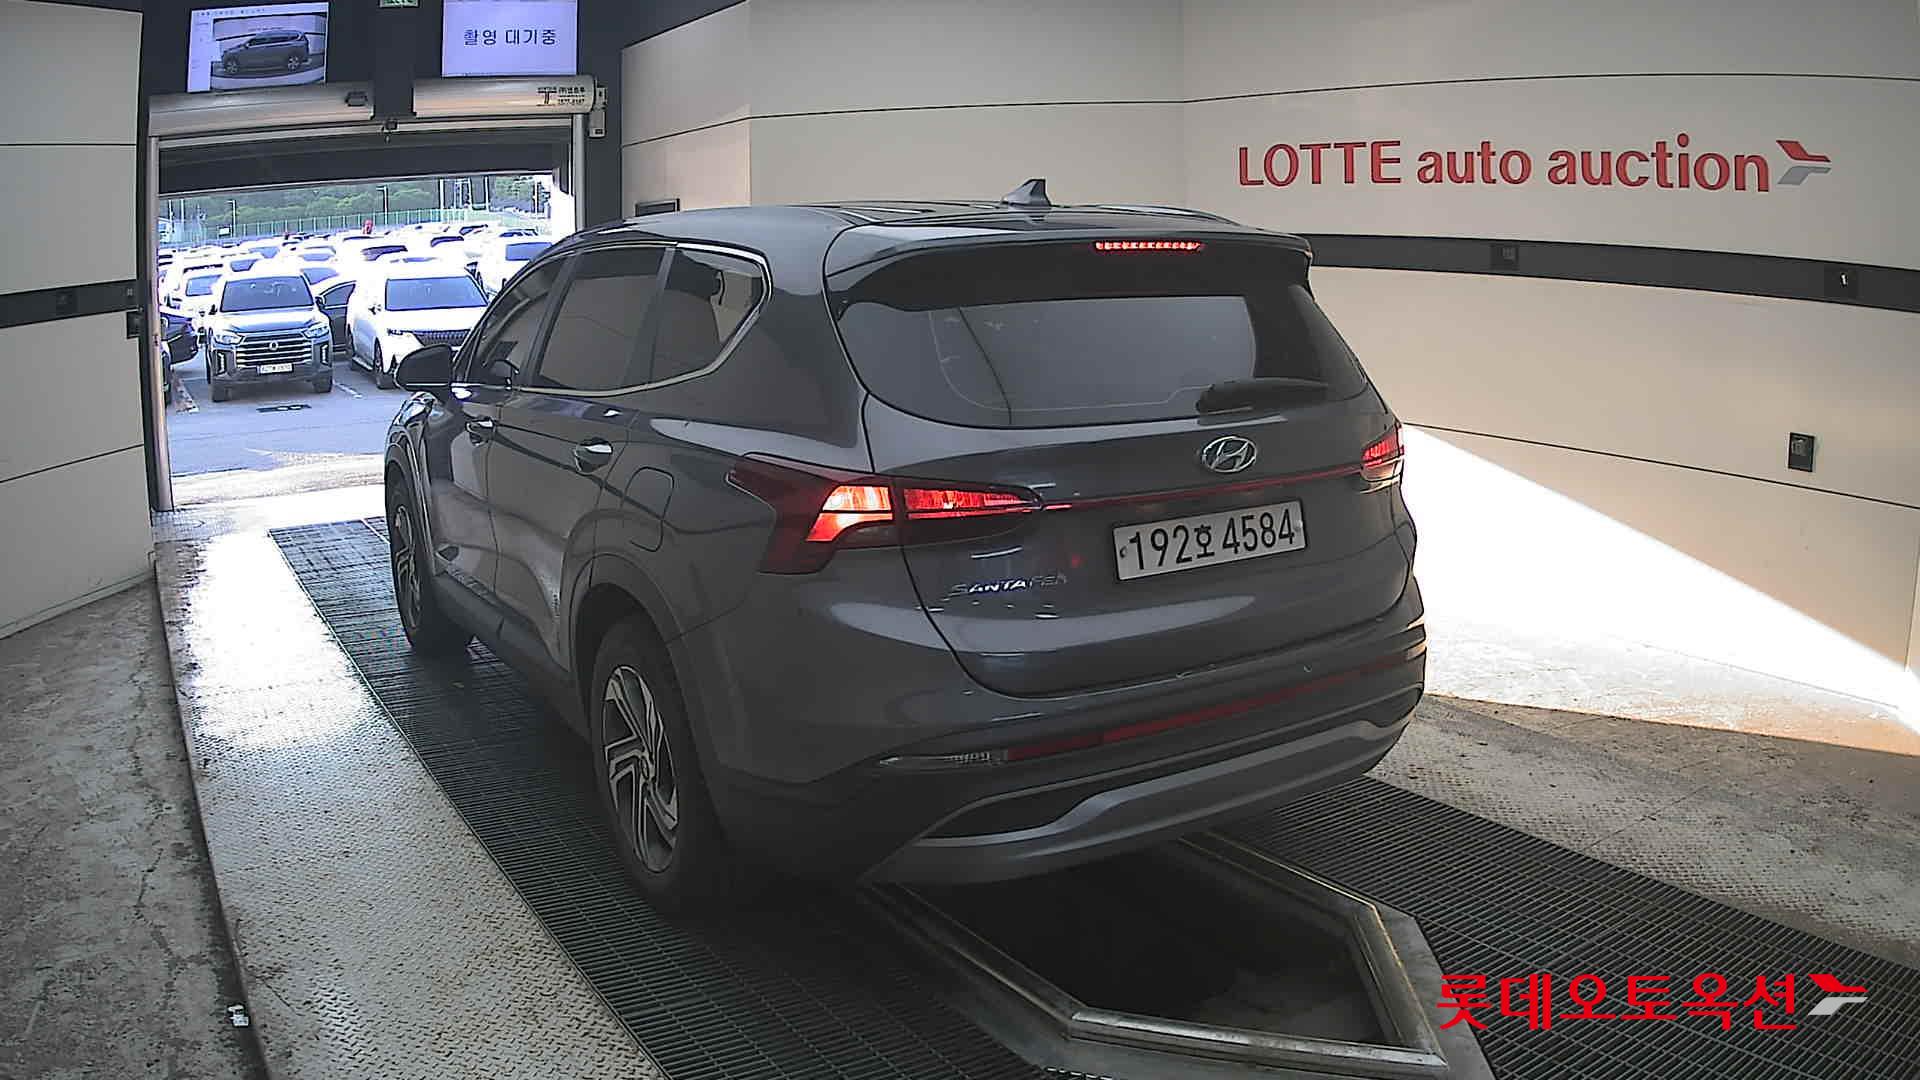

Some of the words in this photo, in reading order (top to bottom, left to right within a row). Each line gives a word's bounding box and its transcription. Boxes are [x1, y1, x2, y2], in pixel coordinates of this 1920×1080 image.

[464, 29, 497, 46] 촬영
[505, 29, 557, 46] 대기중
[1238, 140, 1401, 187] LOTTE
[1416, 141, 1532, 184] auto
[1547, 133, 1770, 193] auction
[1129, 524, 1215, 570] 192호
[1222, 508, 1295, 554] 4584
